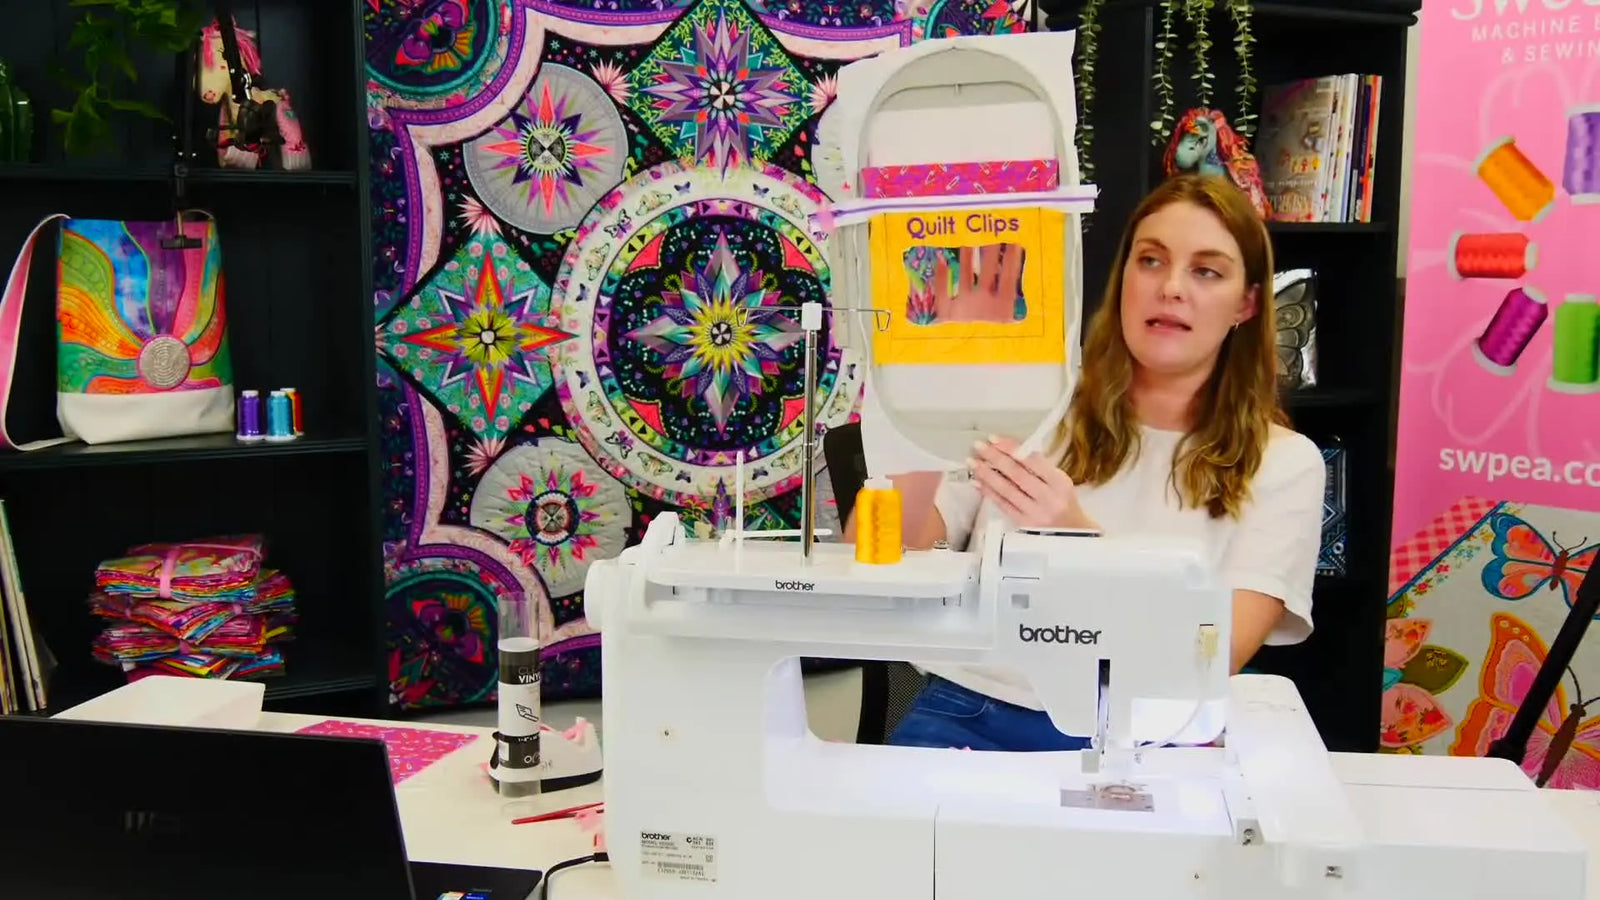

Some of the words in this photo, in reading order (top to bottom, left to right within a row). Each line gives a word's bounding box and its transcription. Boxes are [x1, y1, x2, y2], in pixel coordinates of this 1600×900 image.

[1471, 15, 1582, 42] MACHINE
[1502, 47, 1514, 64] &
[907, 216, 956, 239] Quilt
[966, 214, 1019, 237] Clips
[1439, 447, 1600, 487] swpea.co
[775, 580, 815, 591] brother
[1019, 623, 1102, 645] brother
[641, 832, 671, 841] brother
